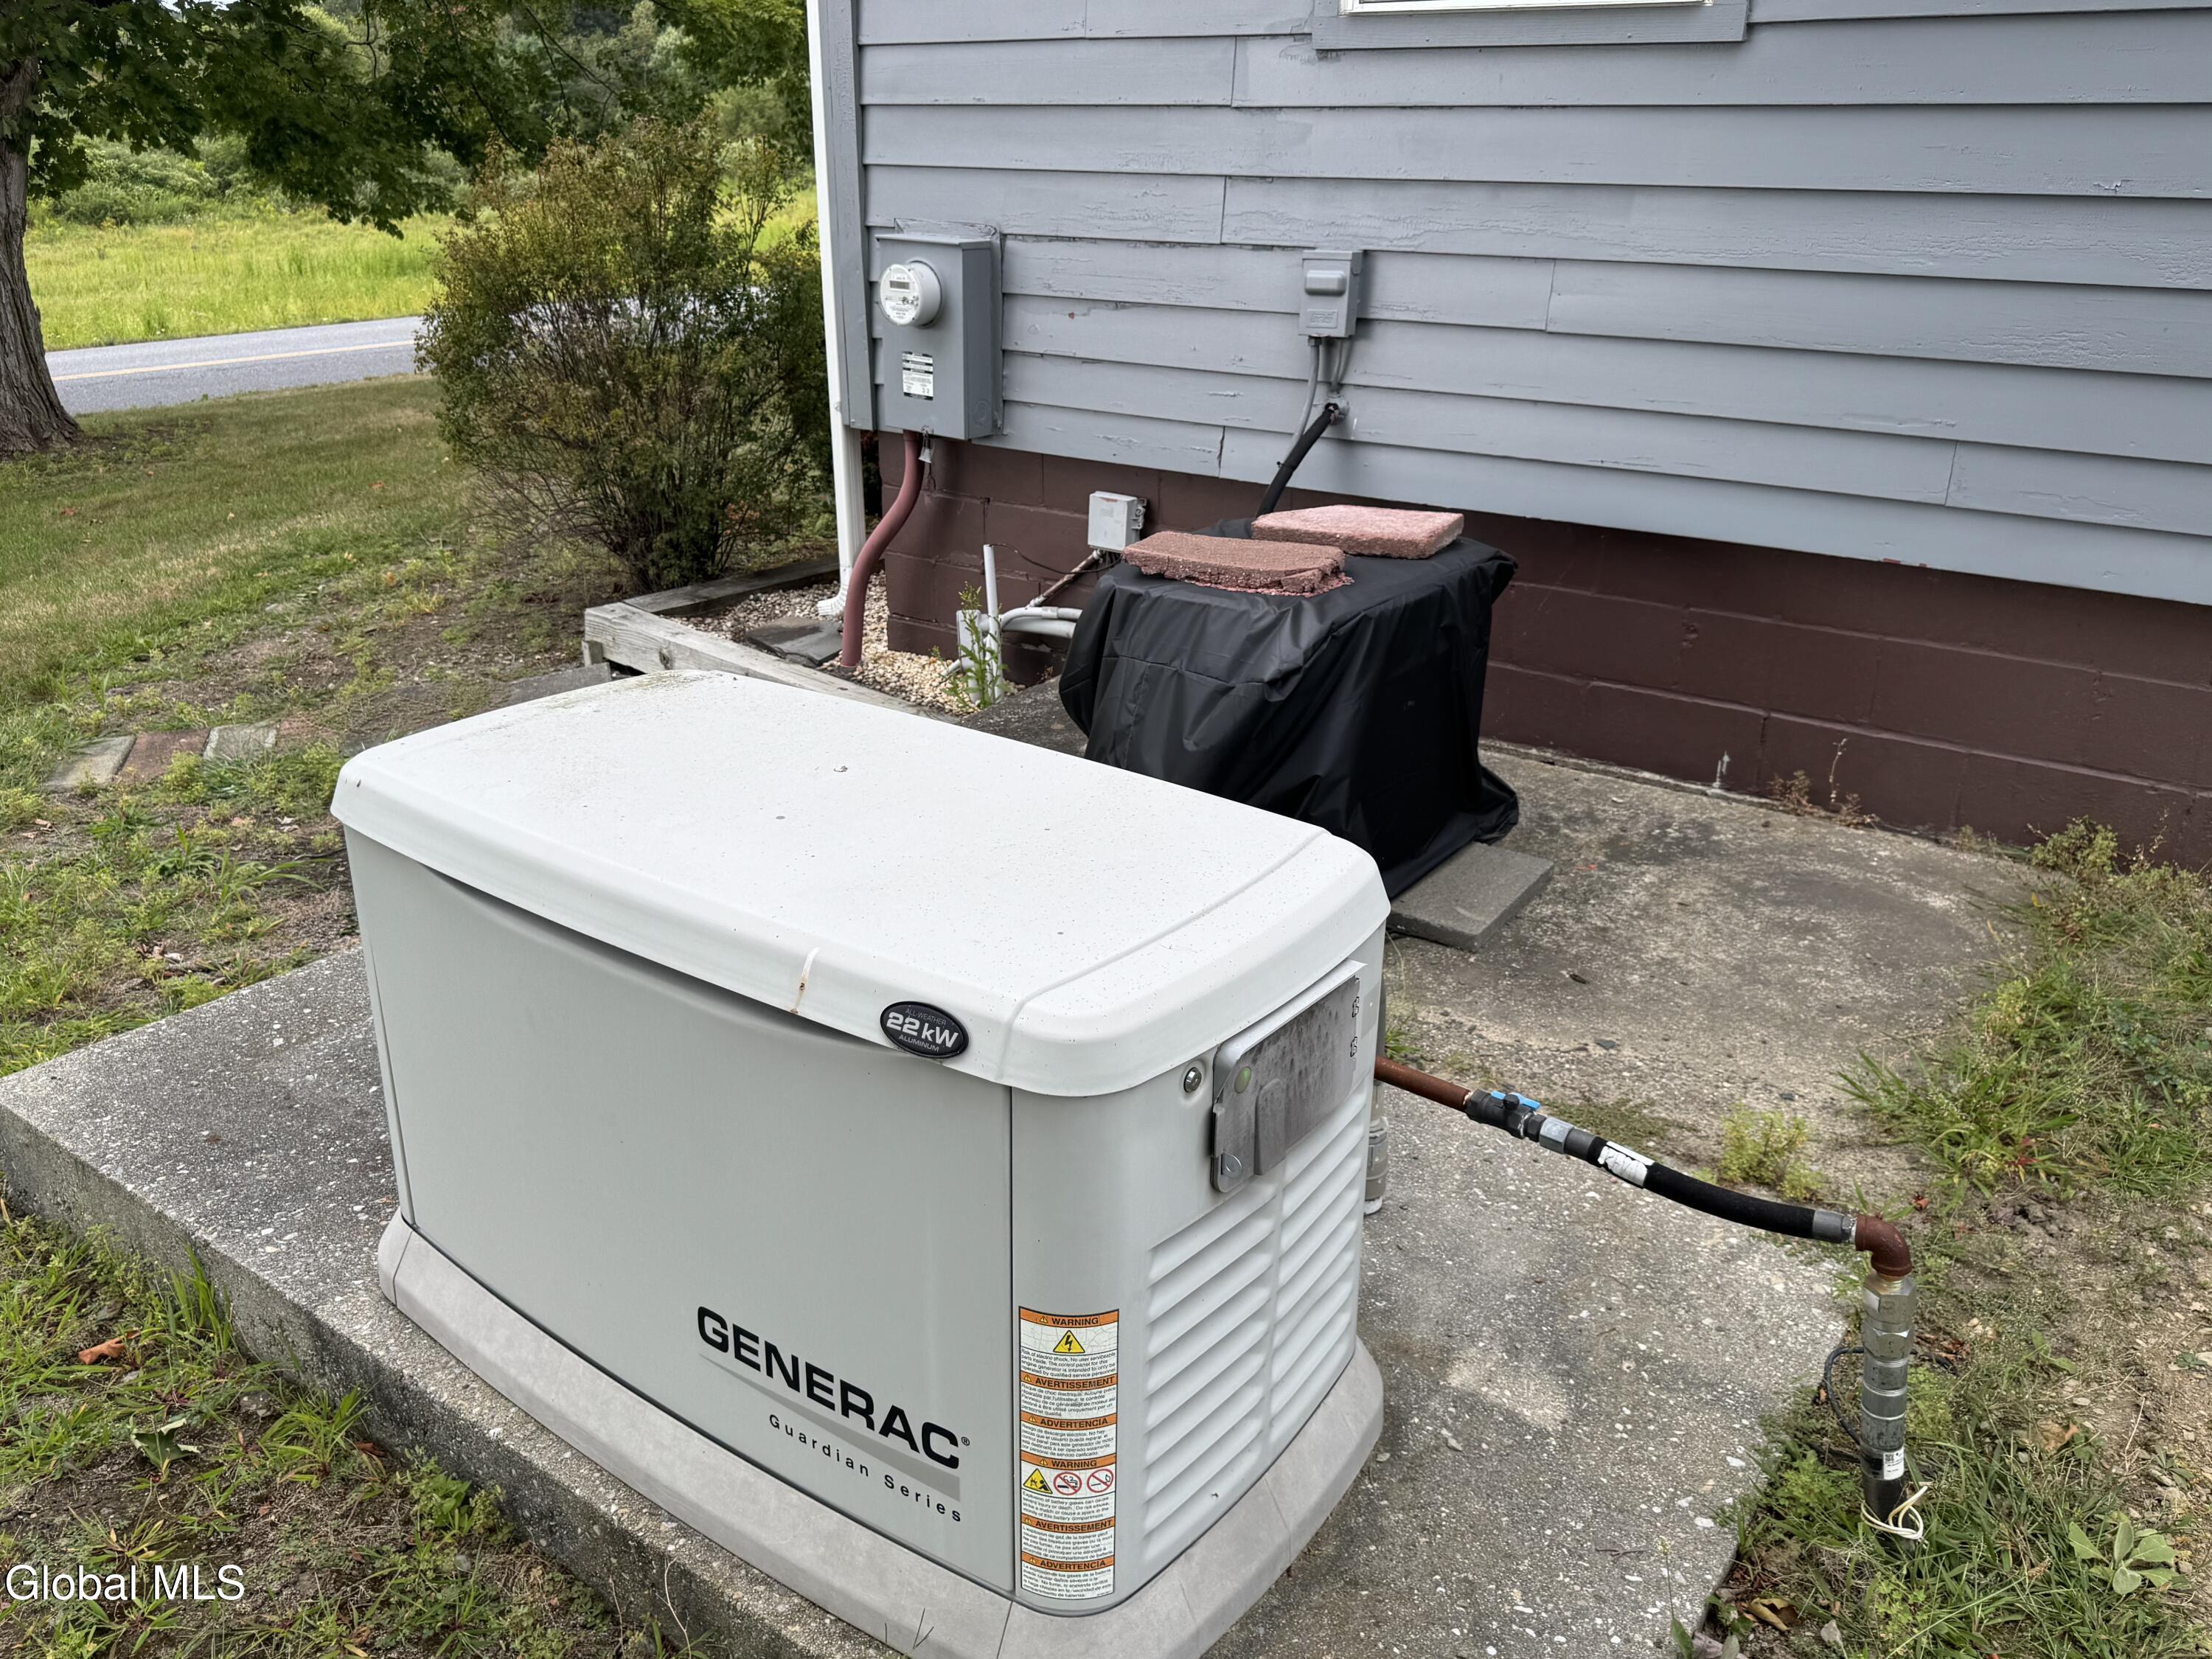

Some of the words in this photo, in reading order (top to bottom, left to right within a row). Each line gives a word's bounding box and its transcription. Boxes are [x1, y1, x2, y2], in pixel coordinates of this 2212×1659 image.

[905, 1008, 947, 1026] ALL-WEATHER
[886, 1012, 920, 1037] 22
[921, 1023, 959, 1048] kW
[898, 1034, 939, 1052] ALUMINUM
[1051, 1318, 1098, 1326] WARNING
[697, 1306, 959, 1470] GENERAC
[1035, 1377, 1114, 1388] AVERTISSEMENT
[1040, 1419, 1107, 1428] ADVERTENCIA
[769, 1413, 869, 1477] Guardian
[884, 1475, 961, 1523] Series
[1035, 1520, 1112, 1531] AVERTISSEMENT
[1040, 1560, 1106, 1570] ADVERTENCIA
